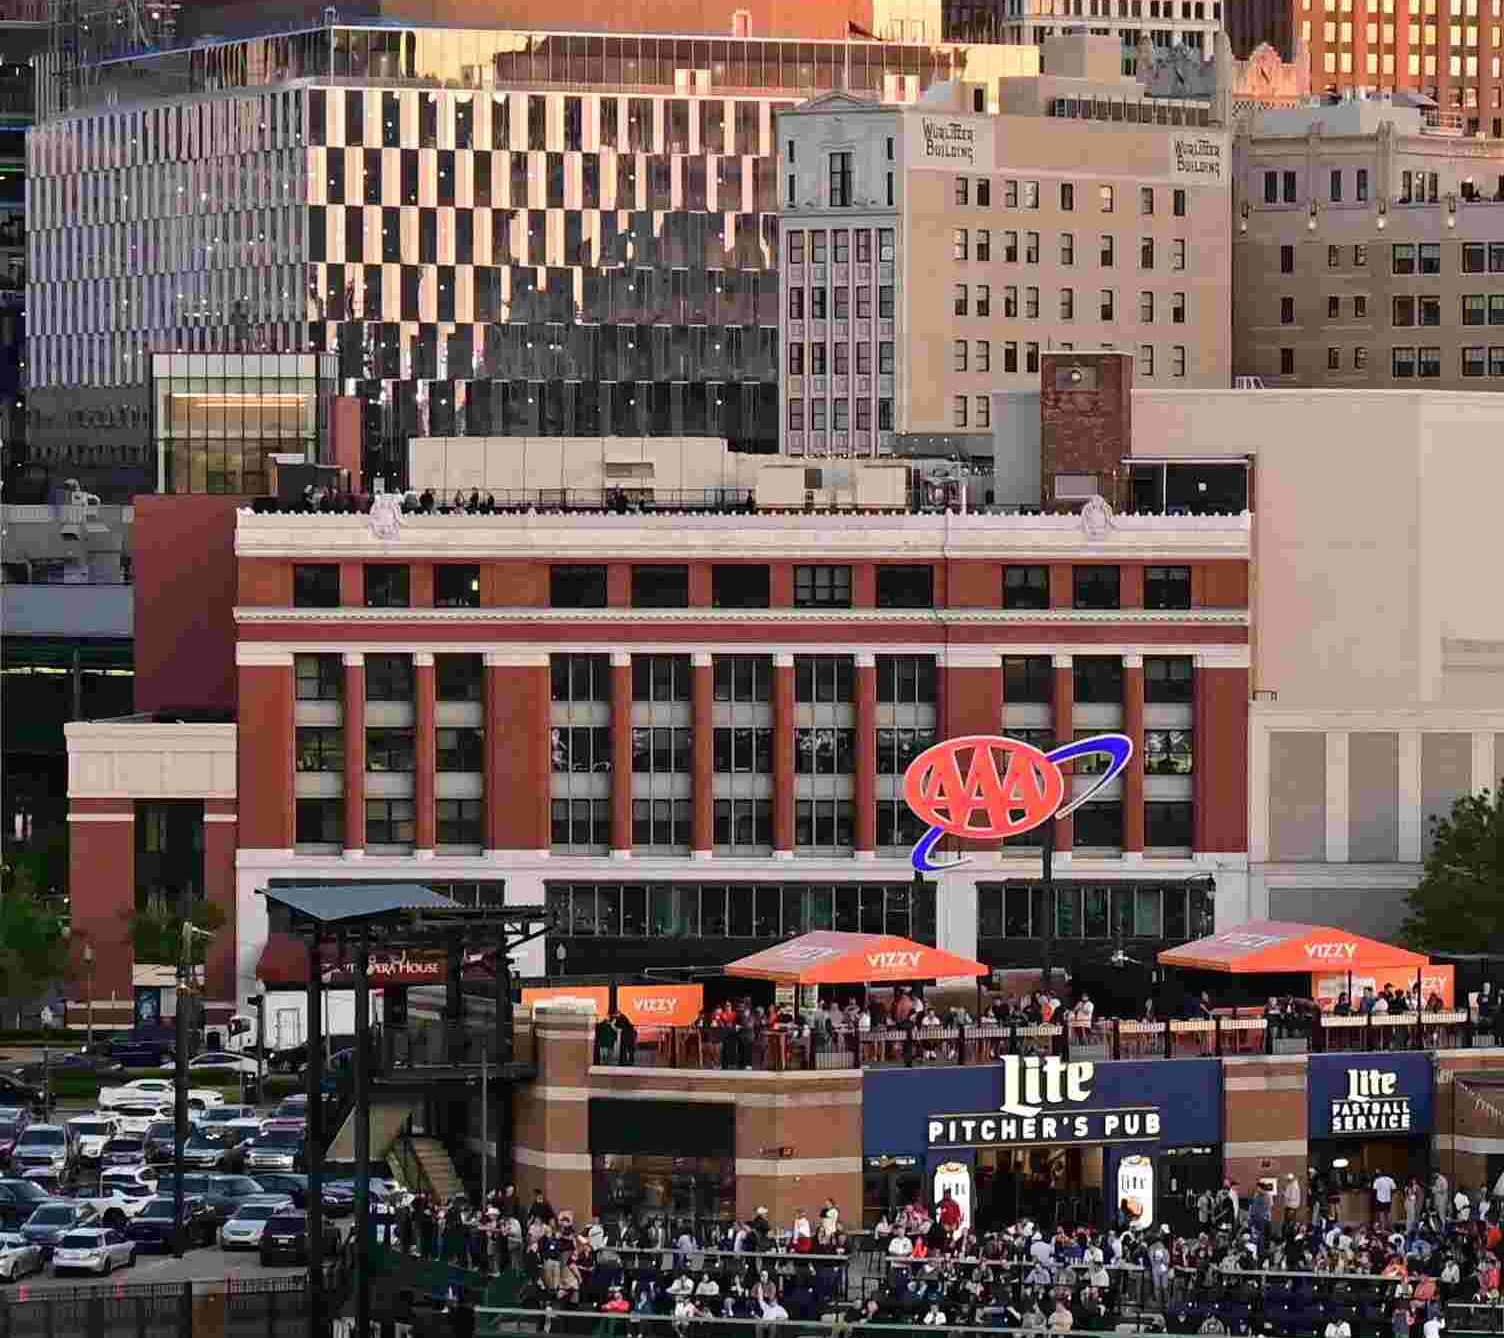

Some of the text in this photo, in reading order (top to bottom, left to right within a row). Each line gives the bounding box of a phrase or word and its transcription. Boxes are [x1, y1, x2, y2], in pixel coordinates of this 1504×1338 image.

[923, 744, 1049, 828] AAA
[866, 950, 921, 968] VIZZY
[1303, 942, 1358, 958] VIZZY
[632, 995, 678, 1014] VIZZY
[1000, 1054, 1095, 1118] Lite
[1347, 1068, 1397, 1100] Lite
[1332, 1101, 1410, 1117] FASTBALL
[928, 1113, 1161, 1143] PITCHER'S PUB
[1332, 1115, 1410, 1131] SERVICE
